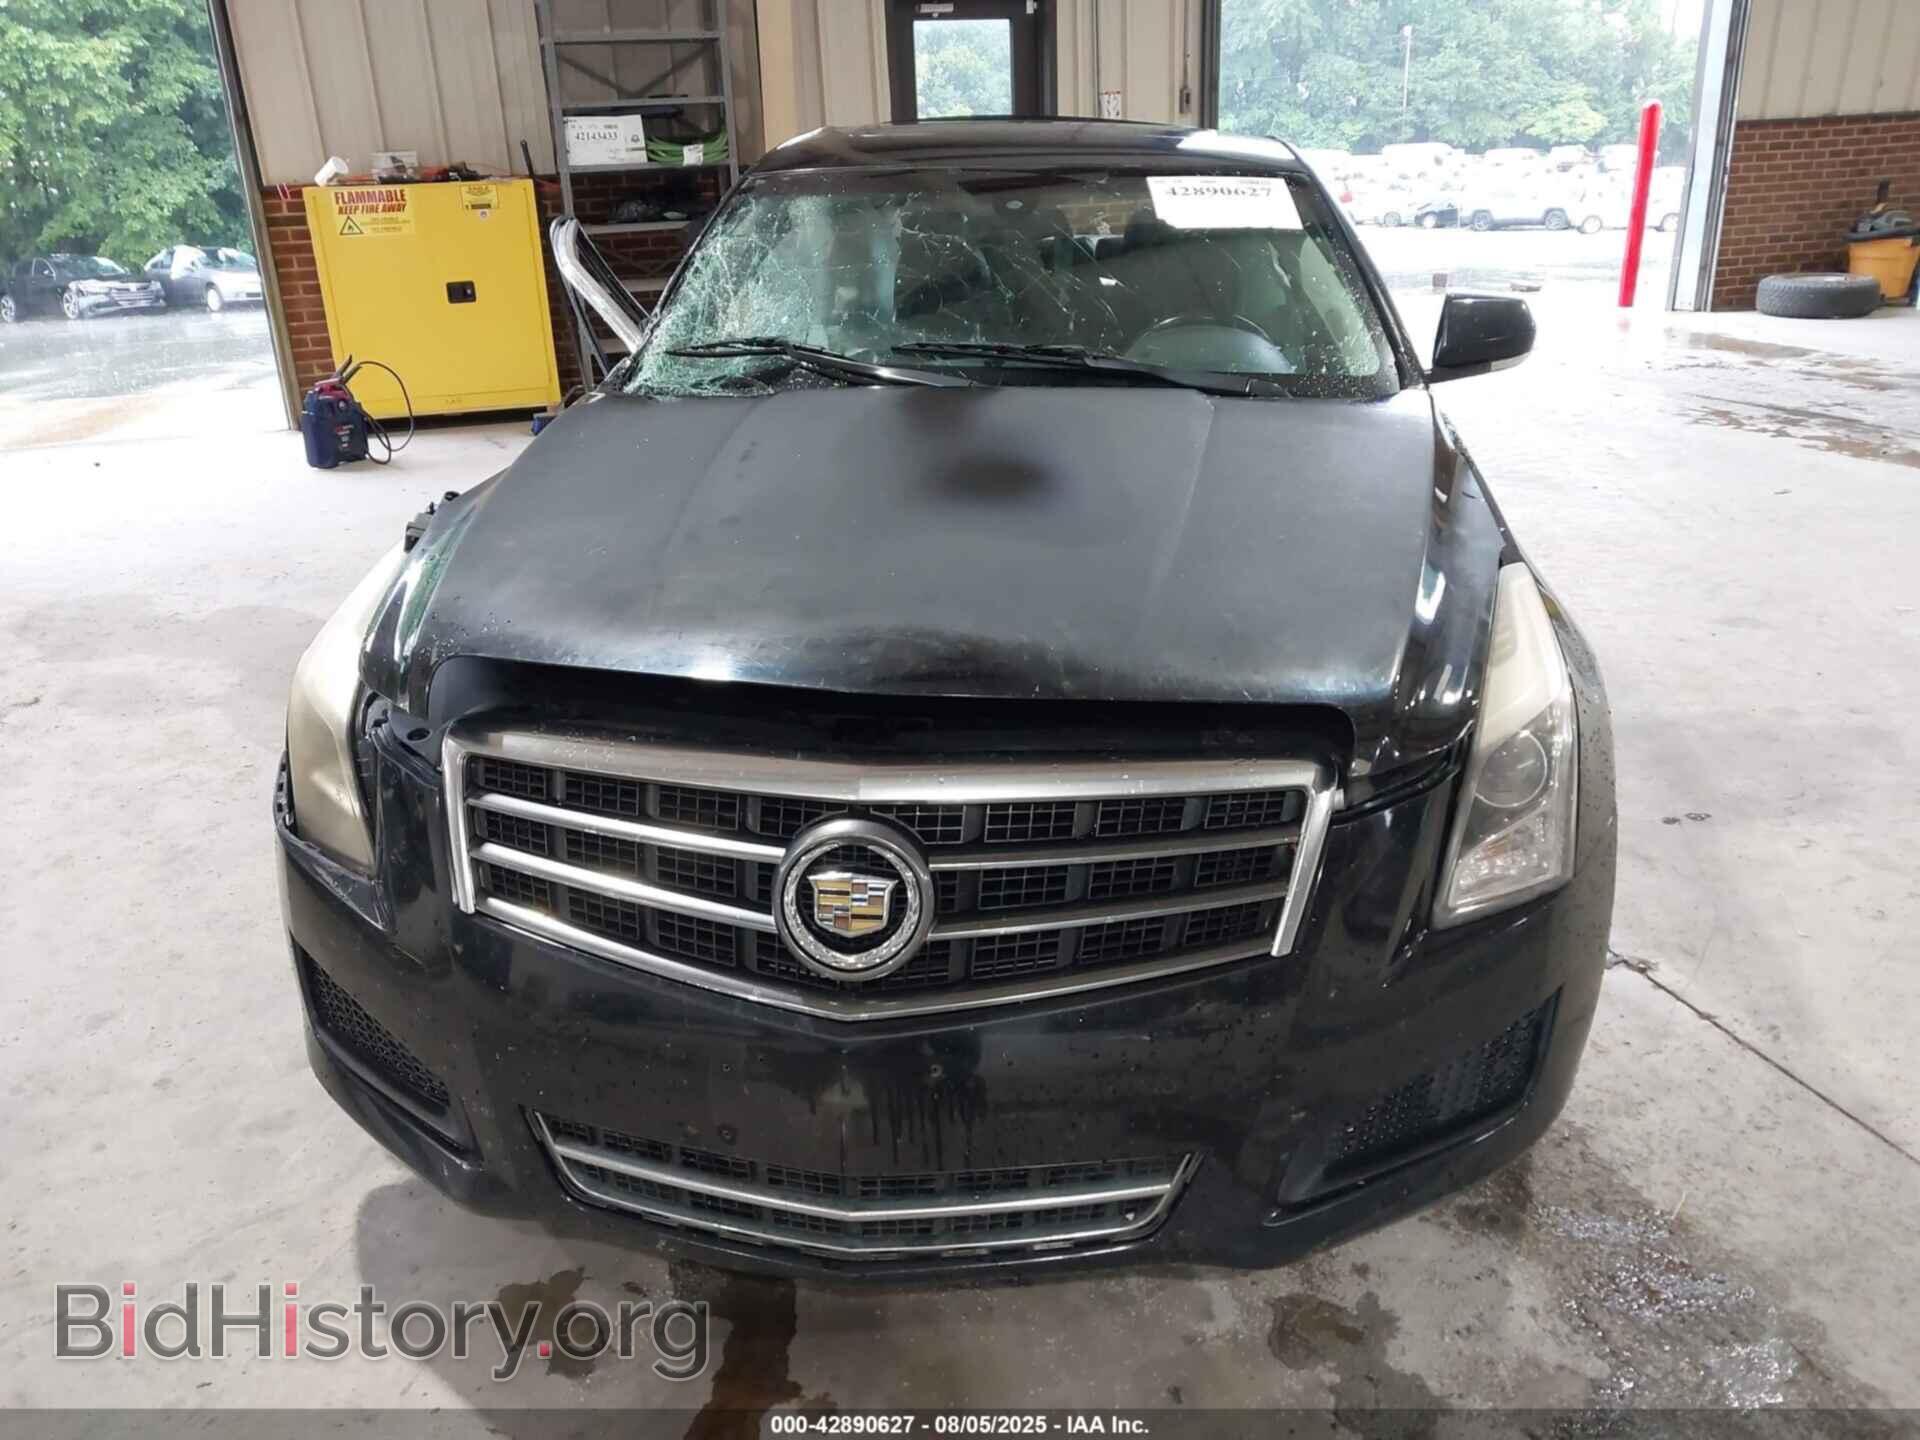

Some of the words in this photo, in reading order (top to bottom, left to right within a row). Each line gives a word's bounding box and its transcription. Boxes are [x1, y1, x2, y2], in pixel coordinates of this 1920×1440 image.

[334, 189, 406, 204] FLAMMABLE
[1165, 186, 1272, 197] 42890627
[338, 204, 360, 215] KEEP
[361, 204, 380, 214] FIRE
[381, 203, 407, 213] AWAY
